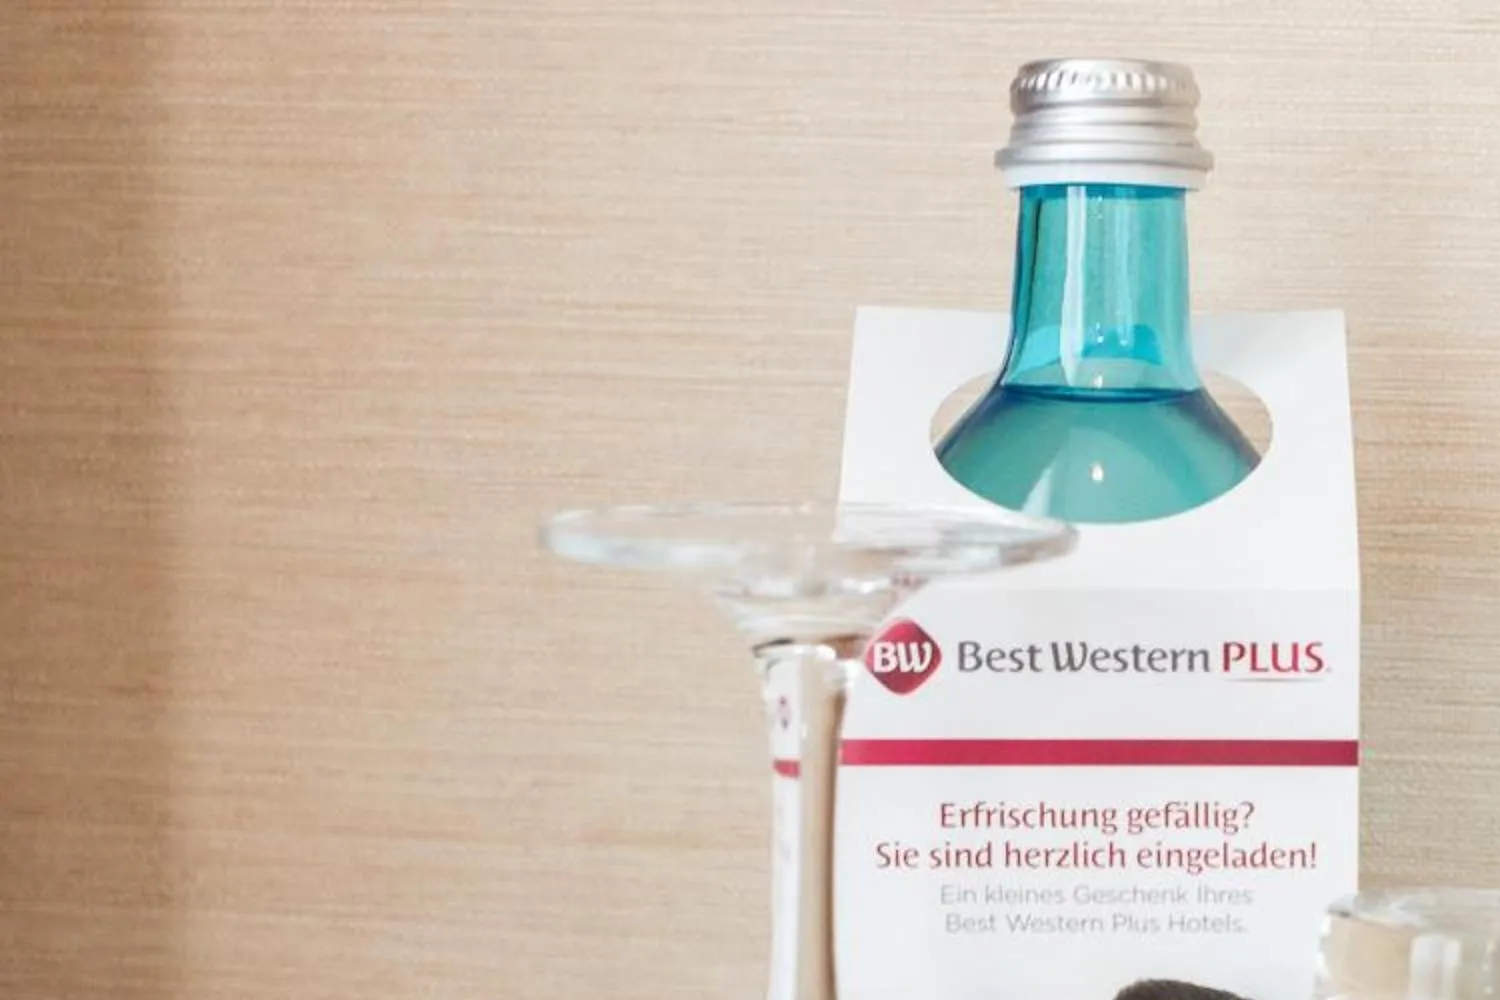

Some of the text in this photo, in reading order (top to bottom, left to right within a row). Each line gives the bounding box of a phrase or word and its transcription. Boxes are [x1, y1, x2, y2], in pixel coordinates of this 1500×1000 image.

[873, 640, 933, 674] BW
[957, 640, 1043, 673] Best
[1050, 640, 1210, 673] Western
[939, 801, 1255, 835] Erfrischung gefällig?
[876, 841, 1317, 876] Sie sind herzlich eingeladen!
[940, 884, 1255, 906] Ein kleines Geschenk Ihres
[945, 913, 996, 934] Best
[1005, 913, 1105, 934] Western
[1112, 913, 1161, 934] Plus
